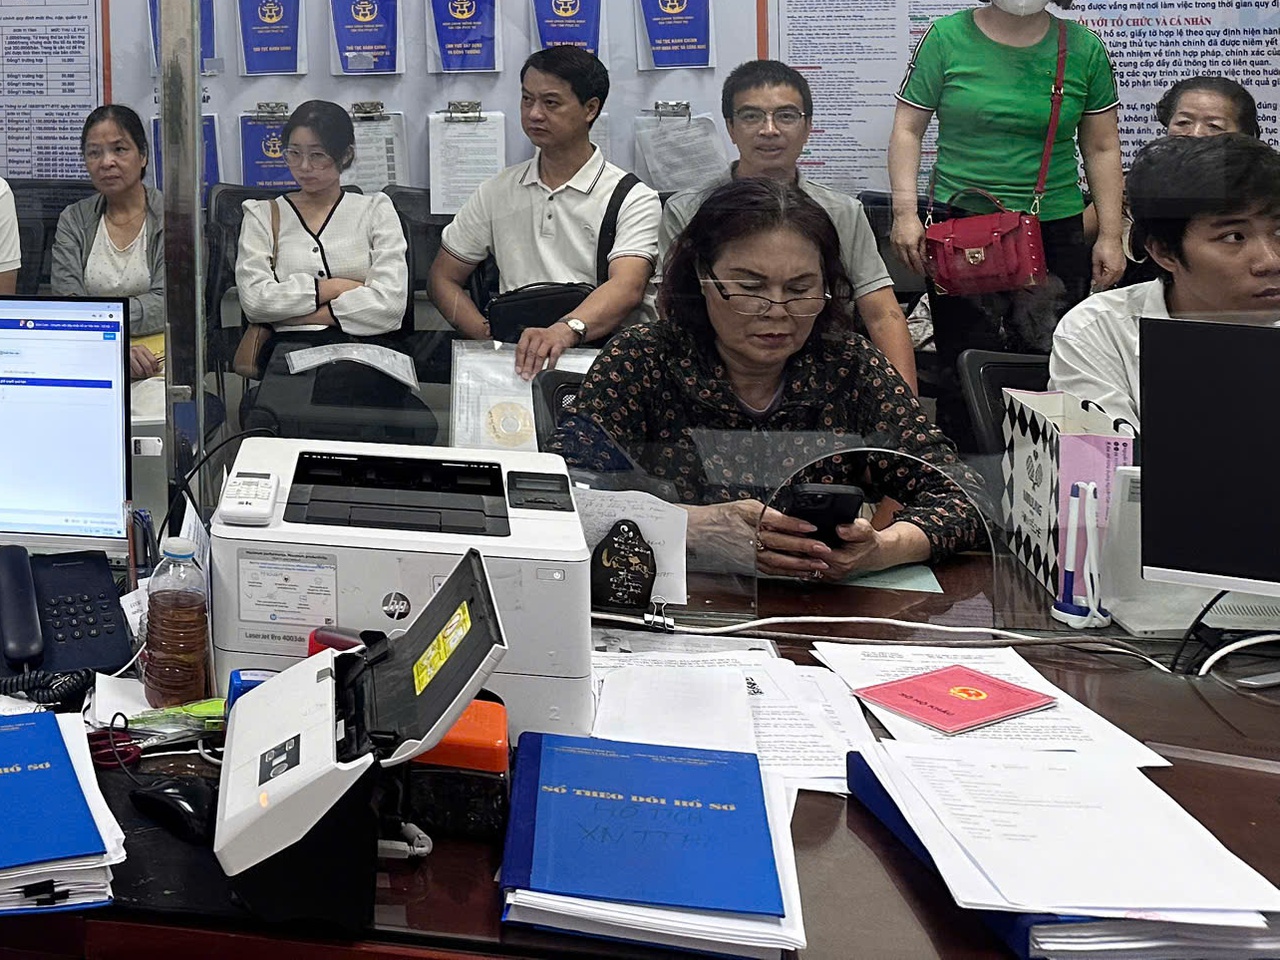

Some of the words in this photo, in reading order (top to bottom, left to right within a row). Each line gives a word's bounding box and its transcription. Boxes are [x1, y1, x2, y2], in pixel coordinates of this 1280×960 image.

[382, 592, 411, 620] hp
[245, 631, 270, 641] LaserJet
[282, 635, 306, 643] 4003dn
